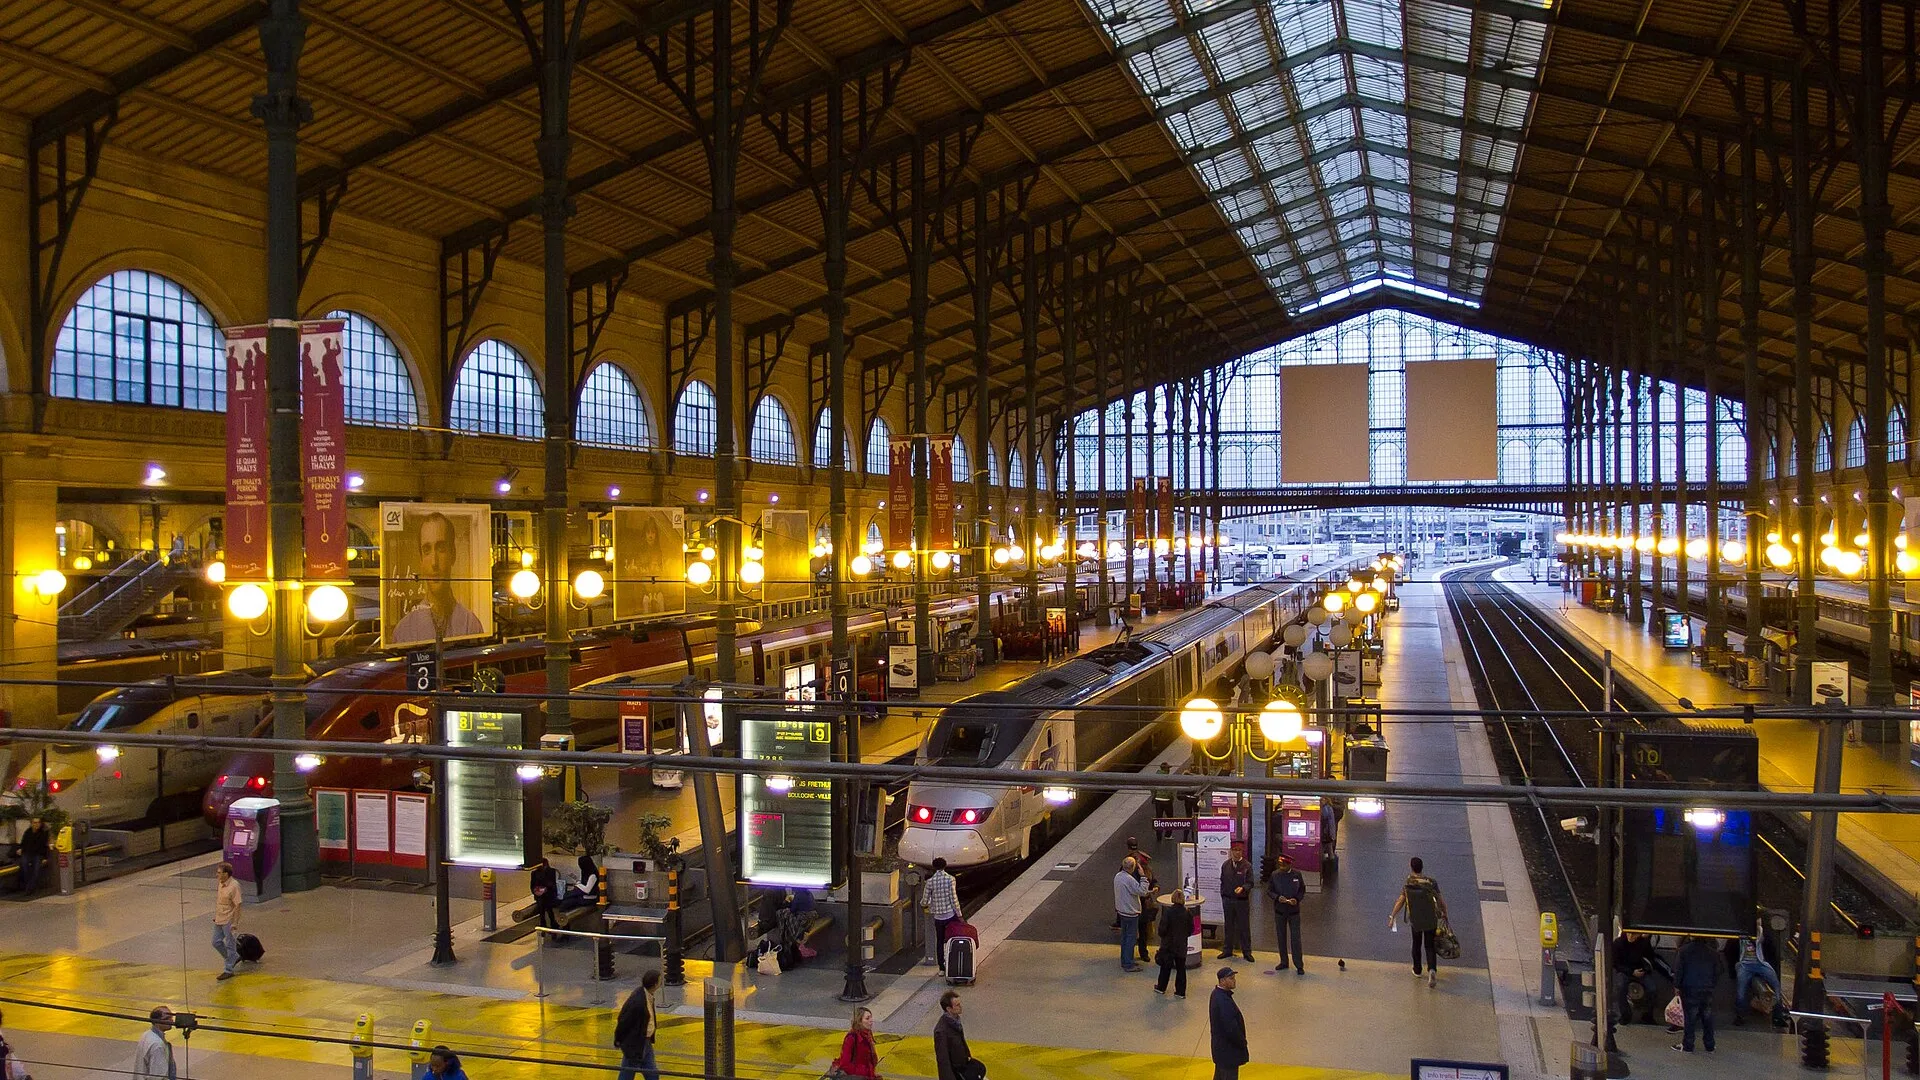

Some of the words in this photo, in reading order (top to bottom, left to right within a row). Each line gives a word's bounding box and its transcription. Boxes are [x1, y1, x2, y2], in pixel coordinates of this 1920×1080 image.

[236, 457, 242, 465] LE
[243, 457, 257, 465] QUAI
[319, 454, 336, 462] QUAI
[236, 464, 257, 472] THALYS
[311, 462, 336, 470] THALYS
[243, 477, 262, 485] THALYS
[318, 475, 340, 483] THALYS
[386, 511, 400, 522] CA
[416, 652, 430, 662] Voie
[838, 660, 849, 670] Voie
[839, 675, 848, 701] 9
[459, 716, 468, 729] 8
[815, 728, 825, 741] 9
[1637, 749, 1659, 764] 10
[1153, 820, 1191, 828] Bienvenue
[1203, 835, 1227, 843] TGV
